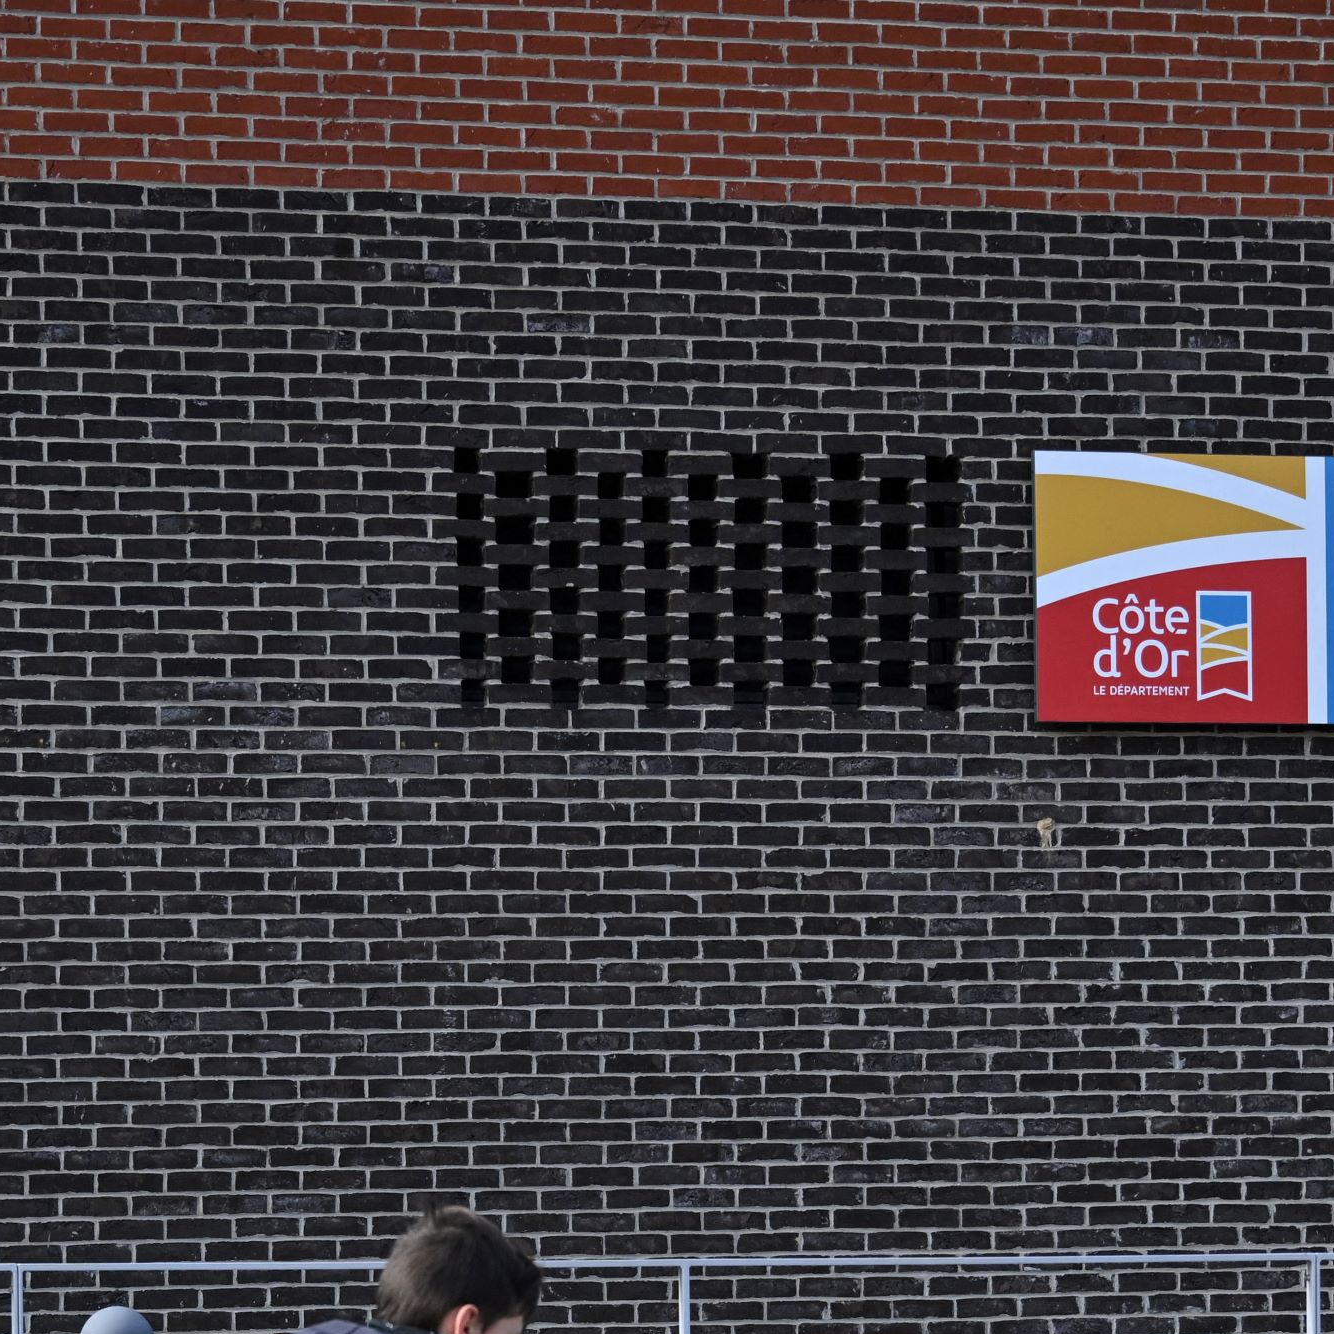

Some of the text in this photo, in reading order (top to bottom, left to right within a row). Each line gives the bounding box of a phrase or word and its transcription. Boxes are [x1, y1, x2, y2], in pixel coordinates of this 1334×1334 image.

[1092, 593, 1190, 636] Côte
[1093, 634, 1190, 679] d'Or
[1093, 683, 1190, 697] LE DÉPARTEMENT
